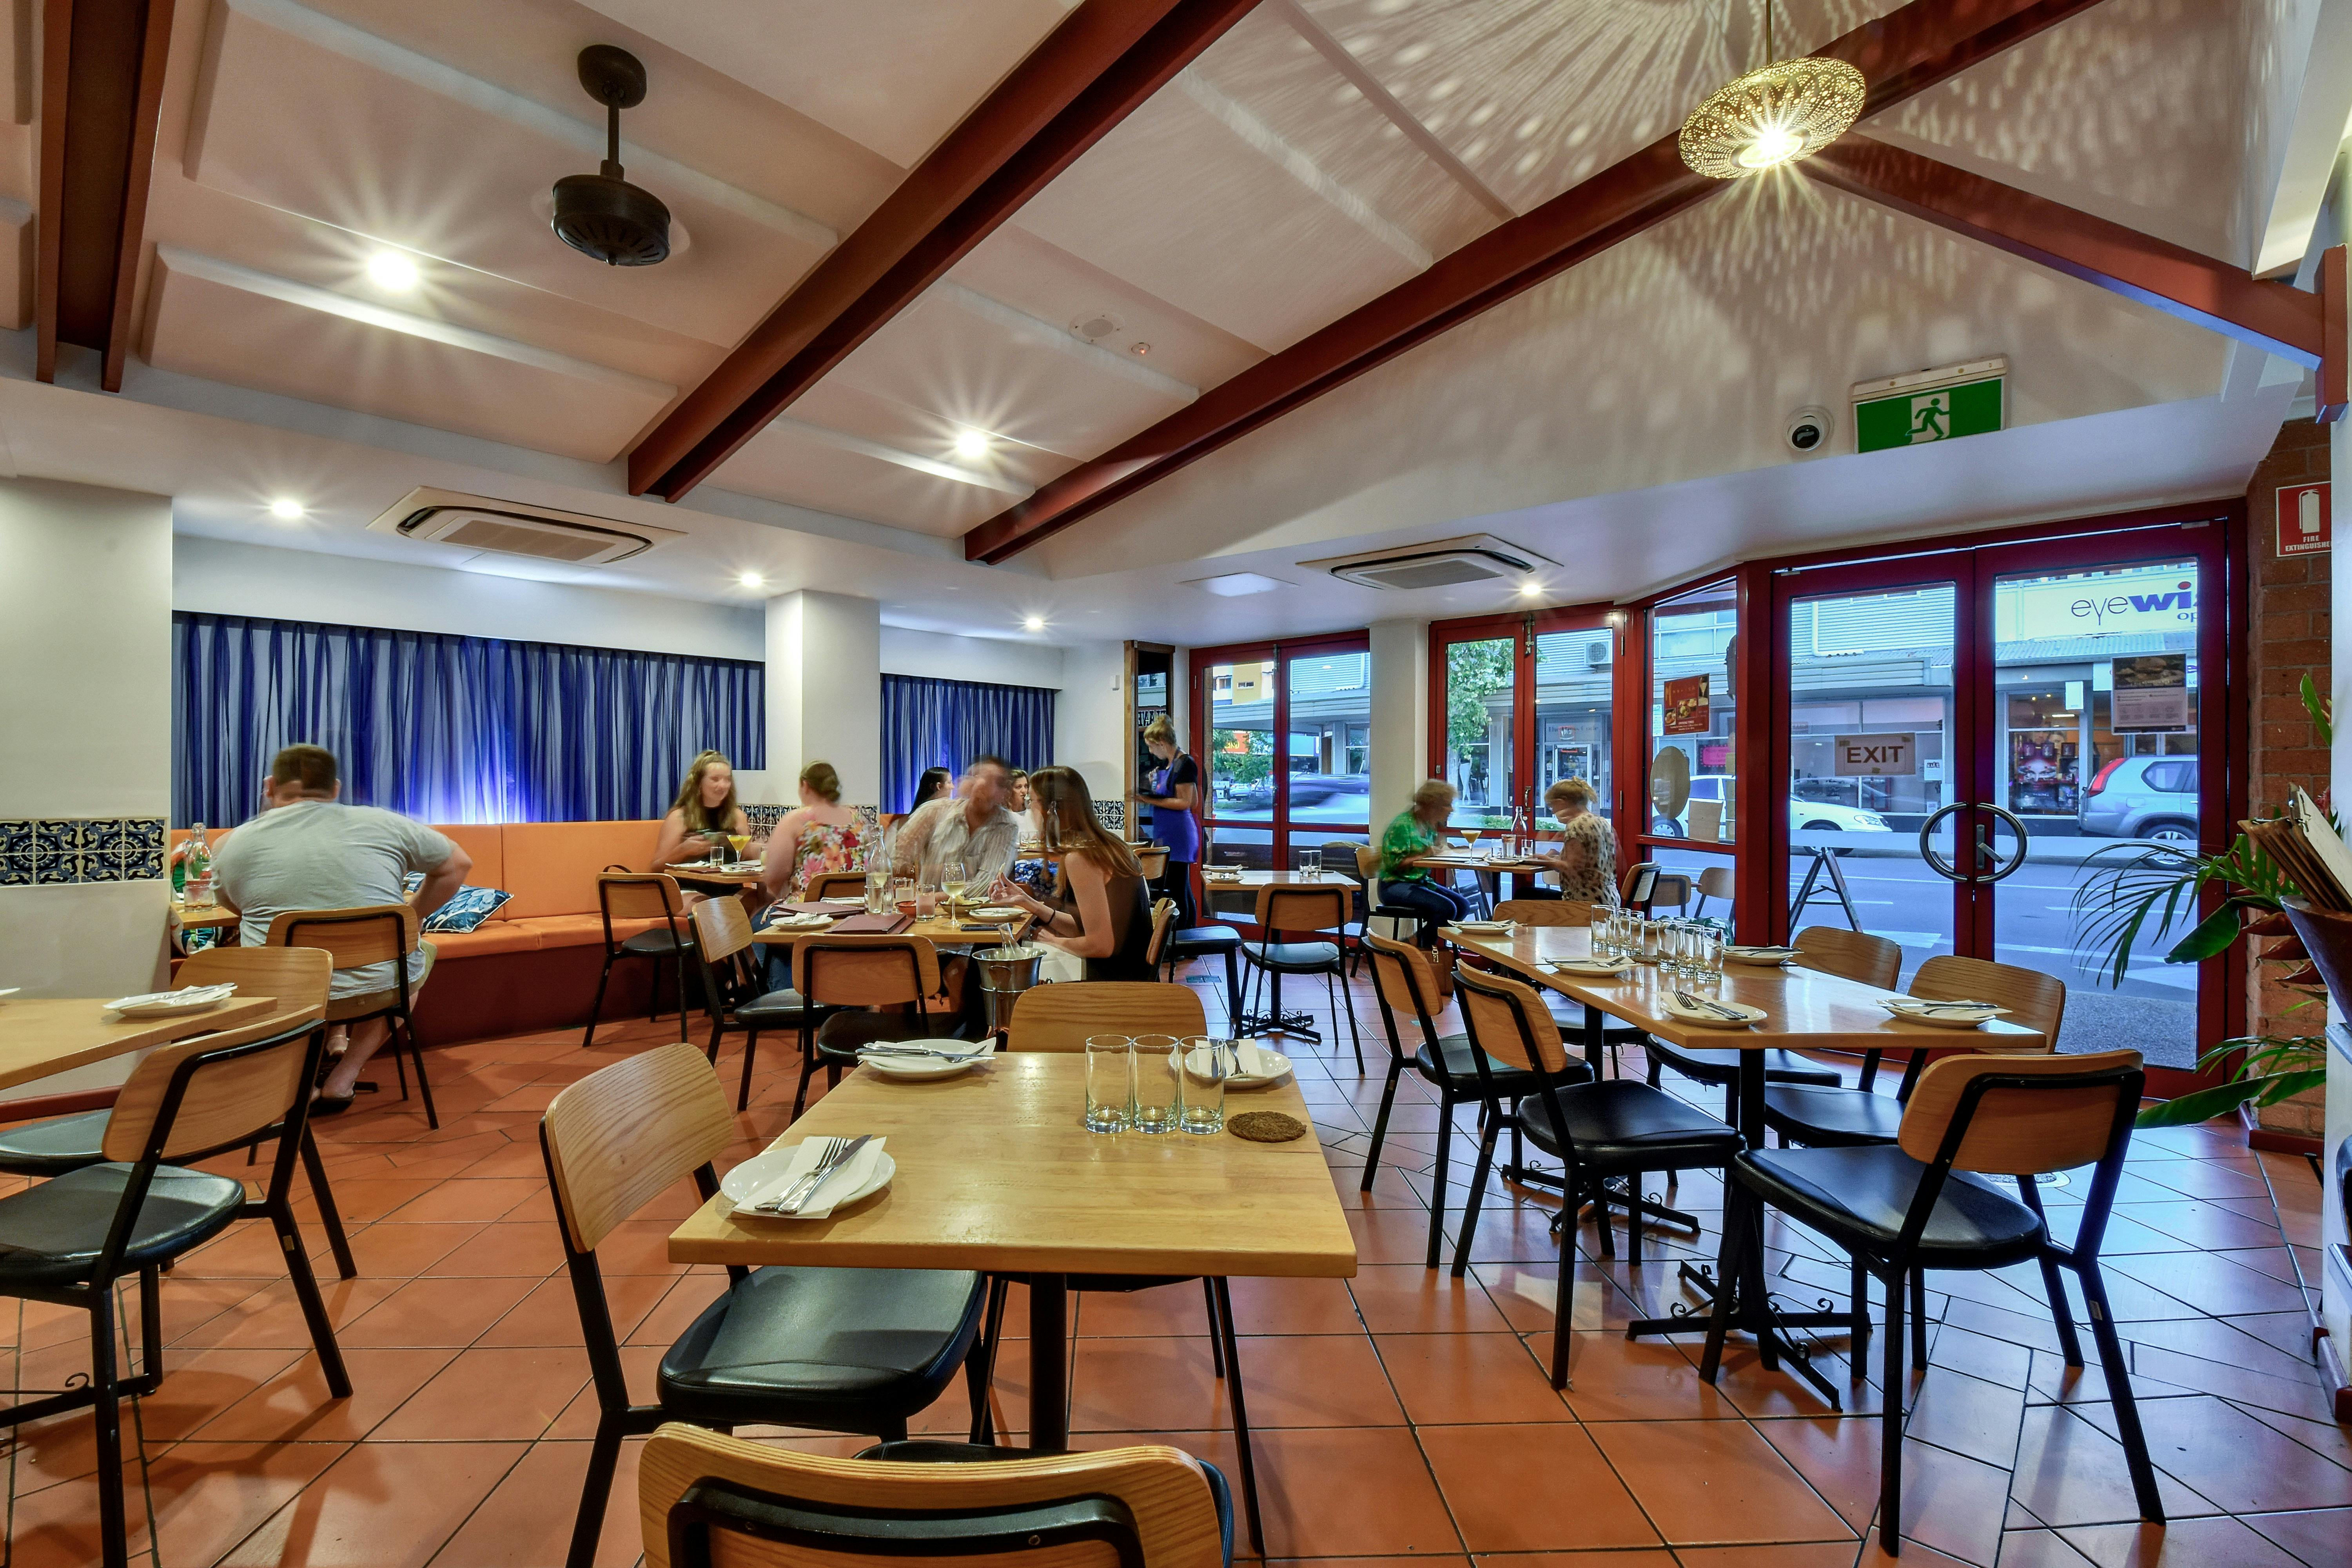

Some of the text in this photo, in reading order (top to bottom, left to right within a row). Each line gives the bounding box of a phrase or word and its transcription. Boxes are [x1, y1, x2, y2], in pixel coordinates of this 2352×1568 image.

[2285, 541, 2331, 552] EXTINGUISHE
[2071, 581, 2197, 626] eyewi
[1847, 746, 1904, 763] EXIT
